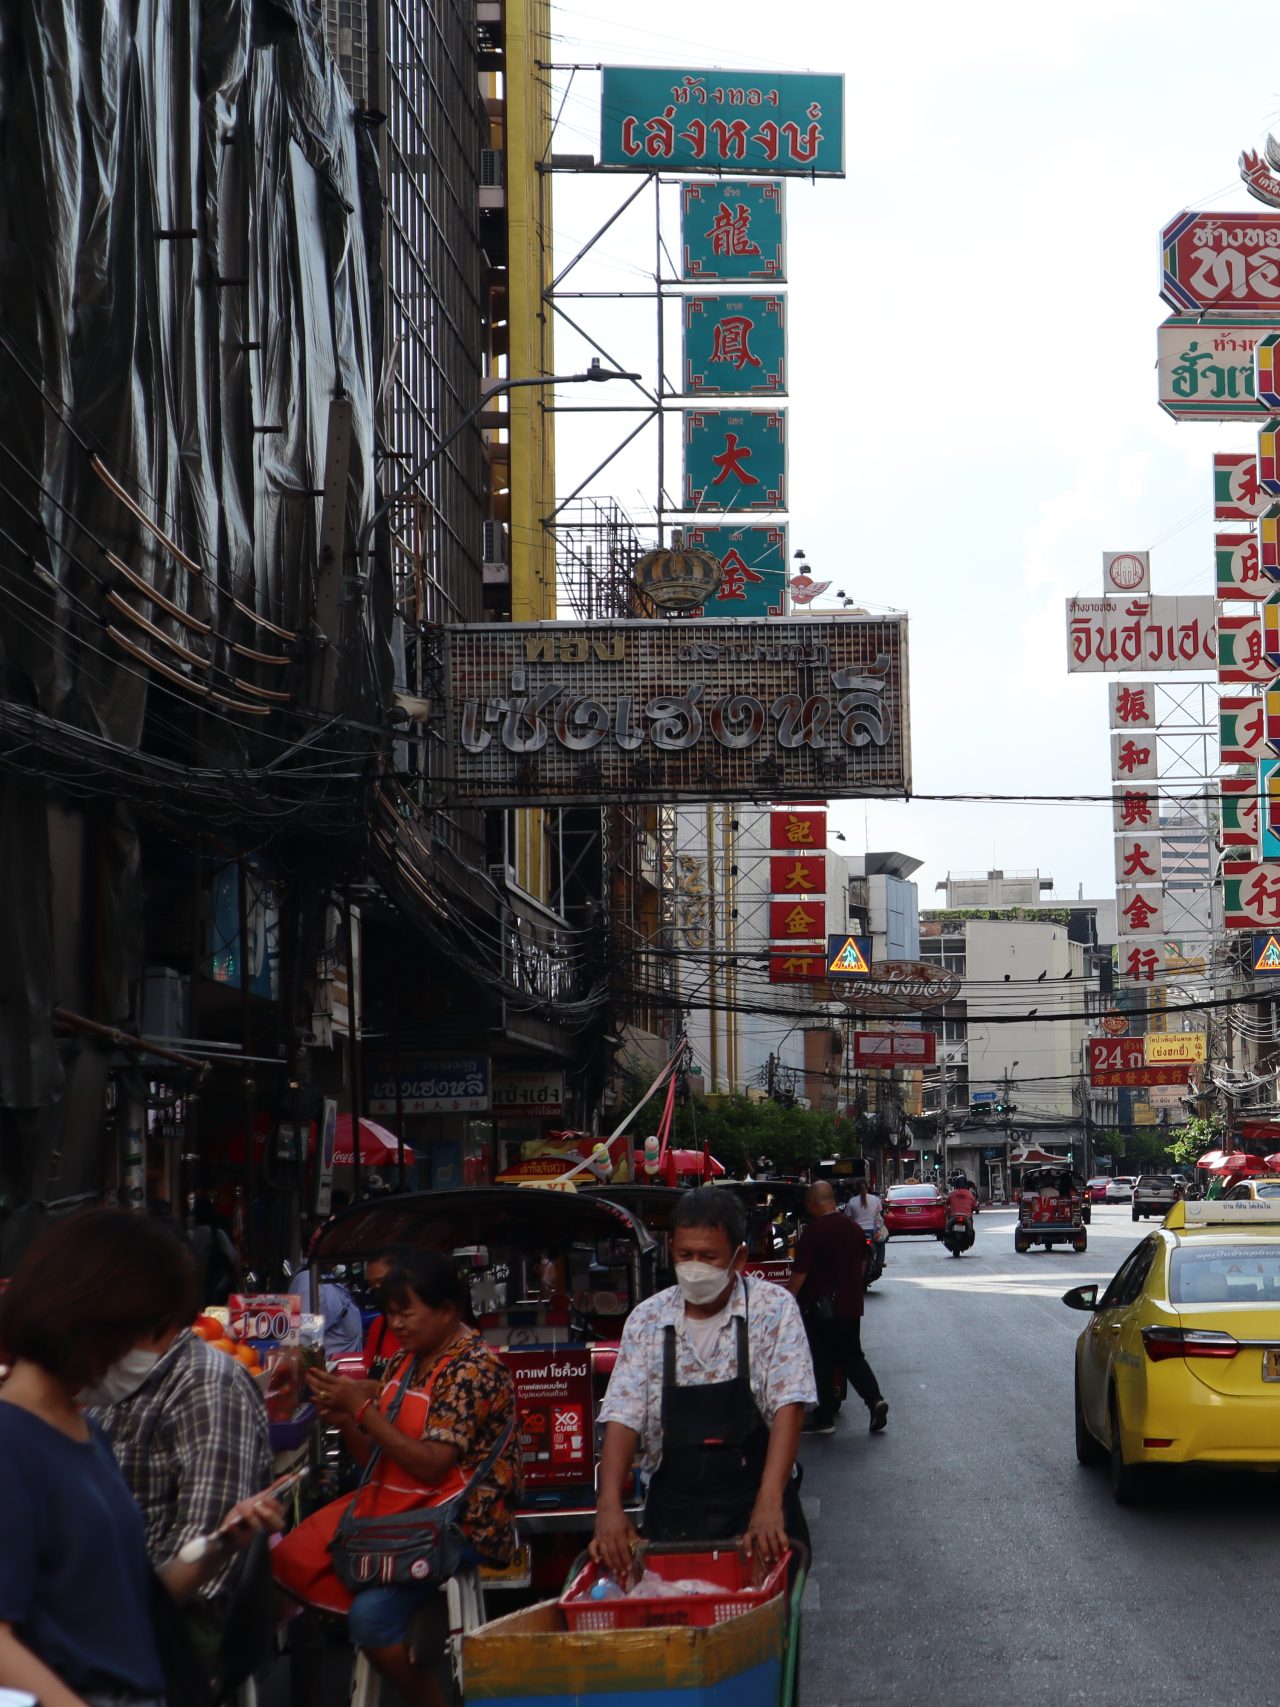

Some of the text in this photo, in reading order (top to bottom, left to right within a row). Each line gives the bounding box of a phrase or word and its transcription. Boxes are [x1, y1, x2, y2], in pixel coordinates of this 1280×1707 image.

[671, 75, 779, 106] ห้างทอง
[621, 102, 825, 163] เล่งหงษ์
[524, 636, 627, 664] ทอง
[1094, 1046, 1123, 1070] 24
[239, 1311, 290, 1339] 100
[515, 1365, 548, 1379] กาแฟ
[554, 1411, 579, 1426] XO
